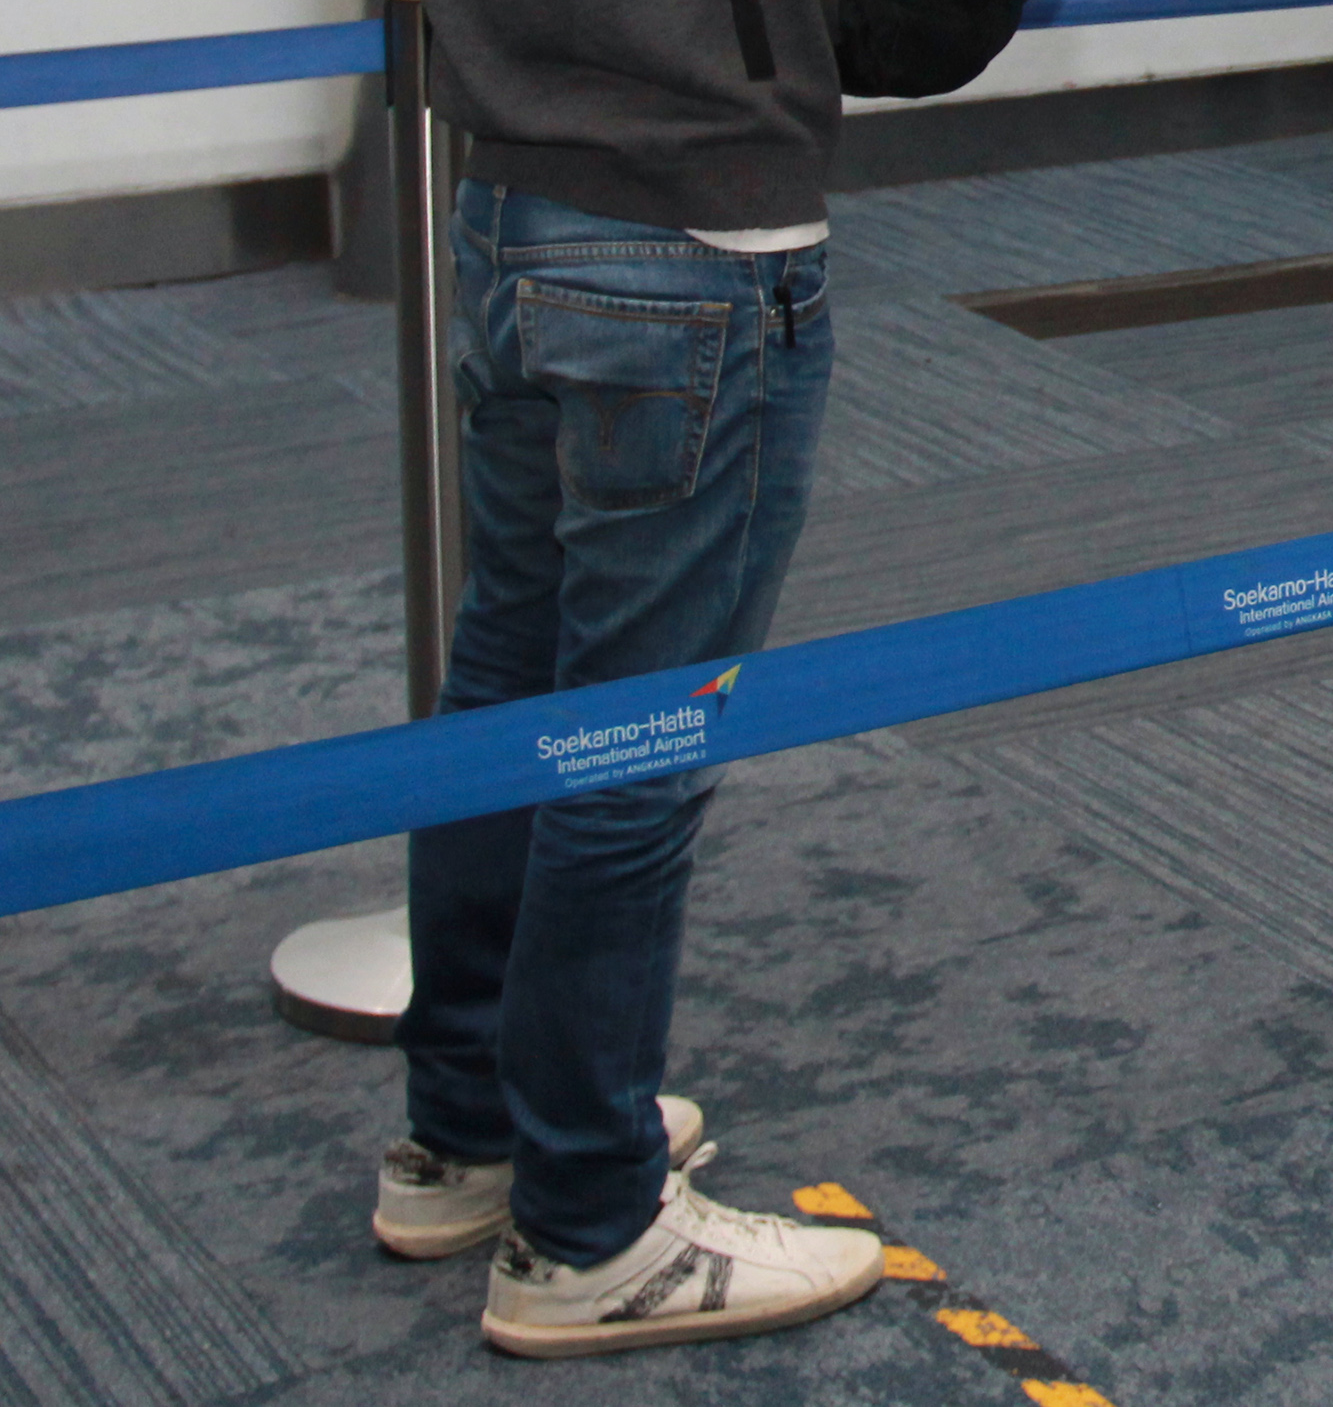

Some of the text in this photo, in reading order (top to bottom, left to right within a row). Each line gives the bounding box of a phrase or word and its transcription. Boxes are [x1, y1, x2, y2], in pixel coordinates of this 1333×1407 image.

[1240, 595, 1315, 624] International
[1295, 611, 1332, 626] ANGKASA
[537, 706, 705, 759] Soekarno-Hatta
[558, 730, 706, 774] International Airport
[626, 757, 672, 775] ANGKASA
[674, 752, 699, 764] PURA
